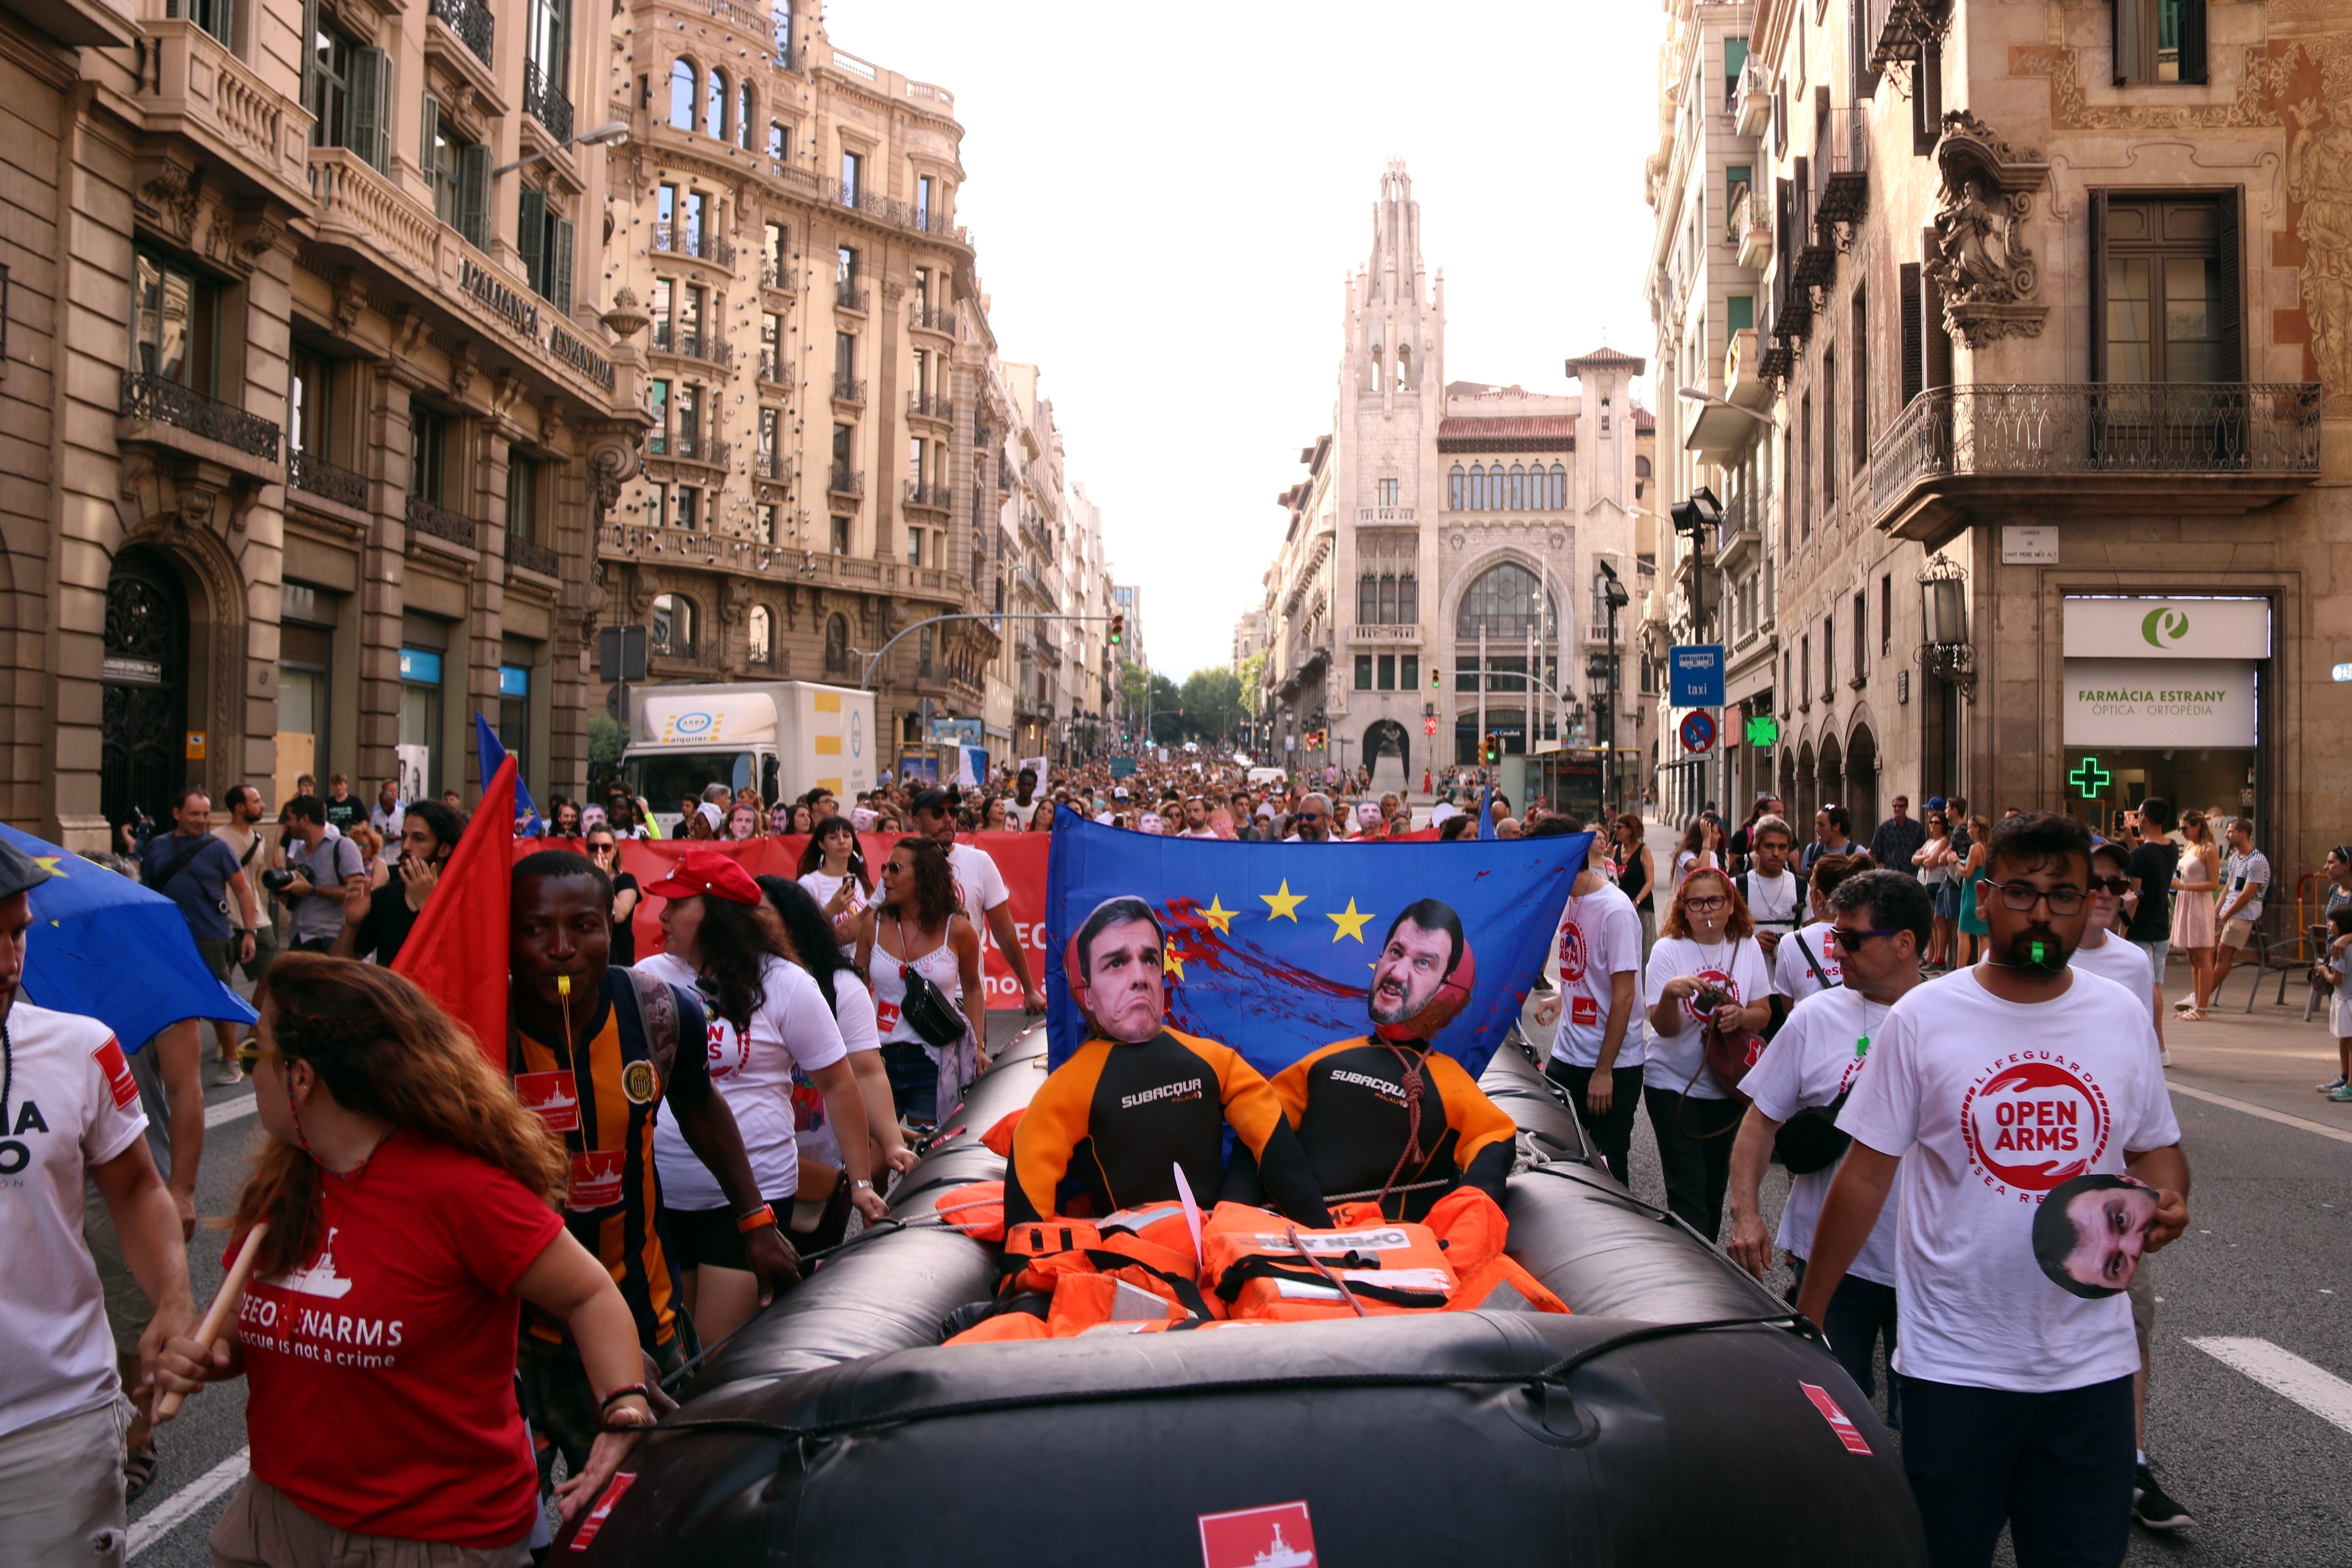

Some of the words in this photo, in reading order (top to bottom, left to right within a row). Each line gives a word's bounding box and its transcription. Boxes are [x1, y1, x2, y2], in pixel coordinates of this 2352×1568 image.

[1687, 682, 1707, 695] taxi
[2078, 688, 2154, 702] FARMÀCIA
[2160, 690, 2226, 702] ESTRANY
[2092, 703, 2135, 715] ÒPTICA
[2147, 703, 2213, 715] ORTOPÈDIA
[1974, 1050, 2093, 1084] LIFEGUARD
[1121, 1077, 1201, 1109] SUBACQUA
[1996, 1101, 2077, 1126] OPEN
[1995, 1127, 2078, 1151] ARMS
[1974, 1166, 2006, 1196] SEA
[295, 1340, 319, 1360] not
[324, 1349, 332, 1363] a
[336, 1350, 395, 1369] crime
